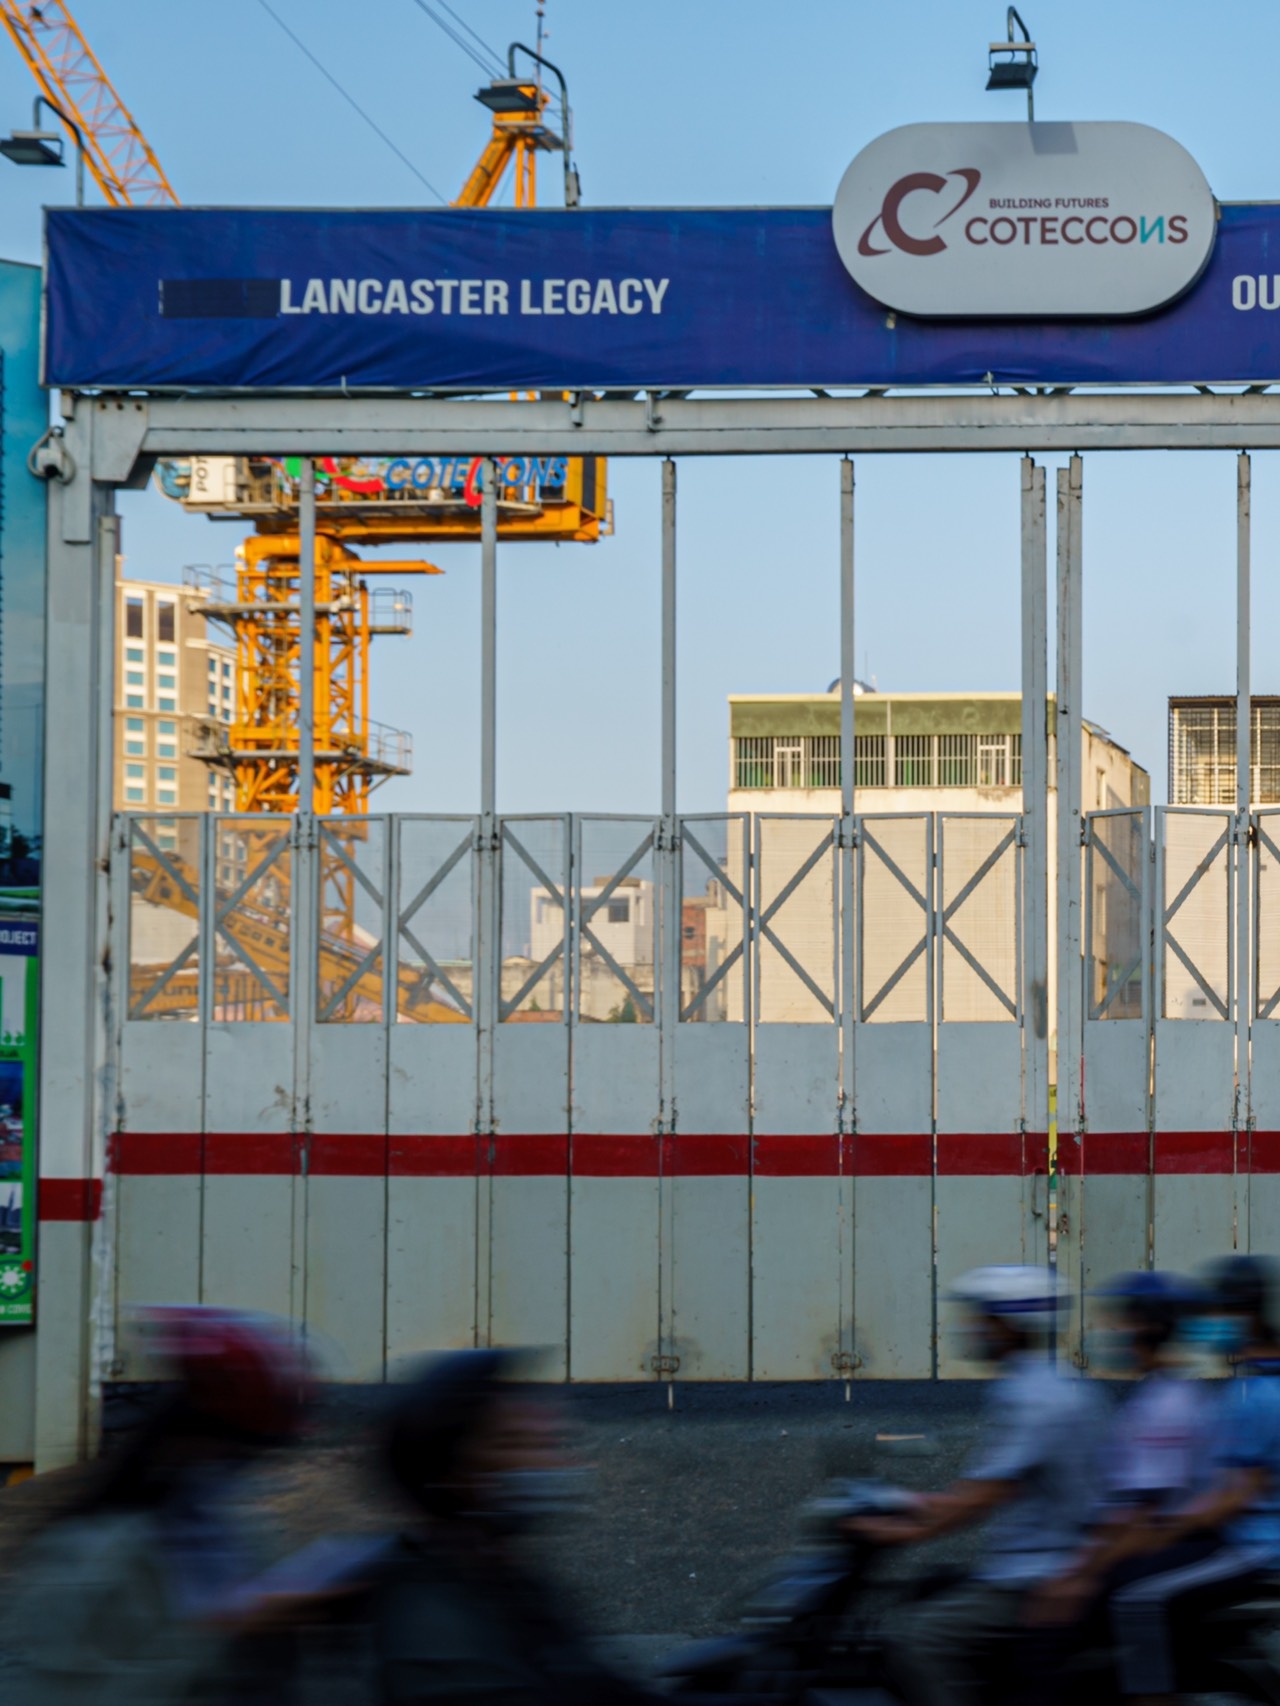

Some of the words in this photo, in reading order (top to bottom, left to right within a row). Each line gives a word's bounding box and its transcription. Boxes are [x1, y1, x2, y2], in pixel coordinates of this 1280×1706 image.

[989, 198, 1052, 209] BUILDING
[1055, 197, 1109, 209] FUTURES
[964, 215, 1188, 245] COTECCONS
[280, 278, 508, 315] LANCASTER
[520, 277, 669, 315] LEGACY
